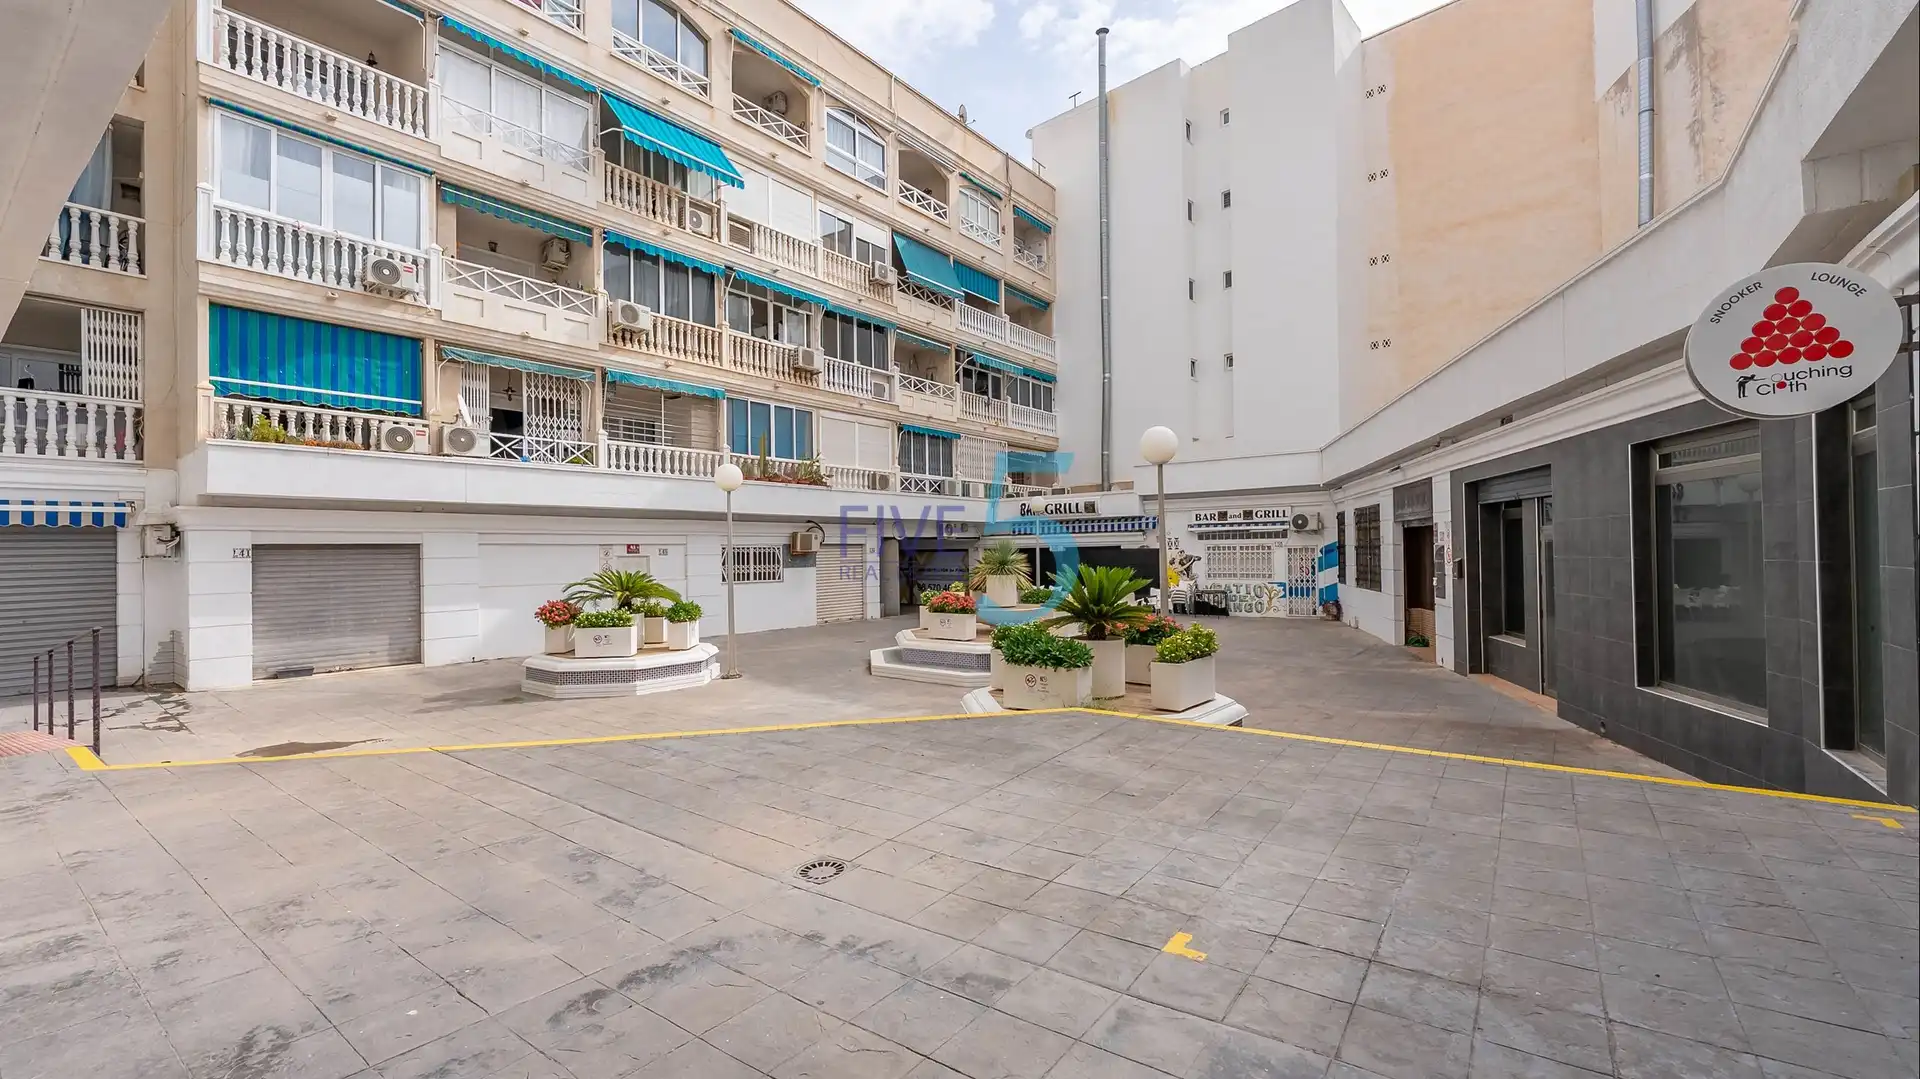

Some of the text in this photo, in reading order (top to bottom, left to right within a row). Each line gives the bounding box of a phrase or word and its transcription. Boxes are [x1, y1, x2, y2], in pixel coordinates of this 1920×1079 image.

[1709, 271, 1868, 325] SNOOKER LOUNGE
[1756, 380, 1808, 396] Cloth
[1044, 502, 1083, 515] GRILL
[1195, 509, 1289, 522] BAR and GRILL
